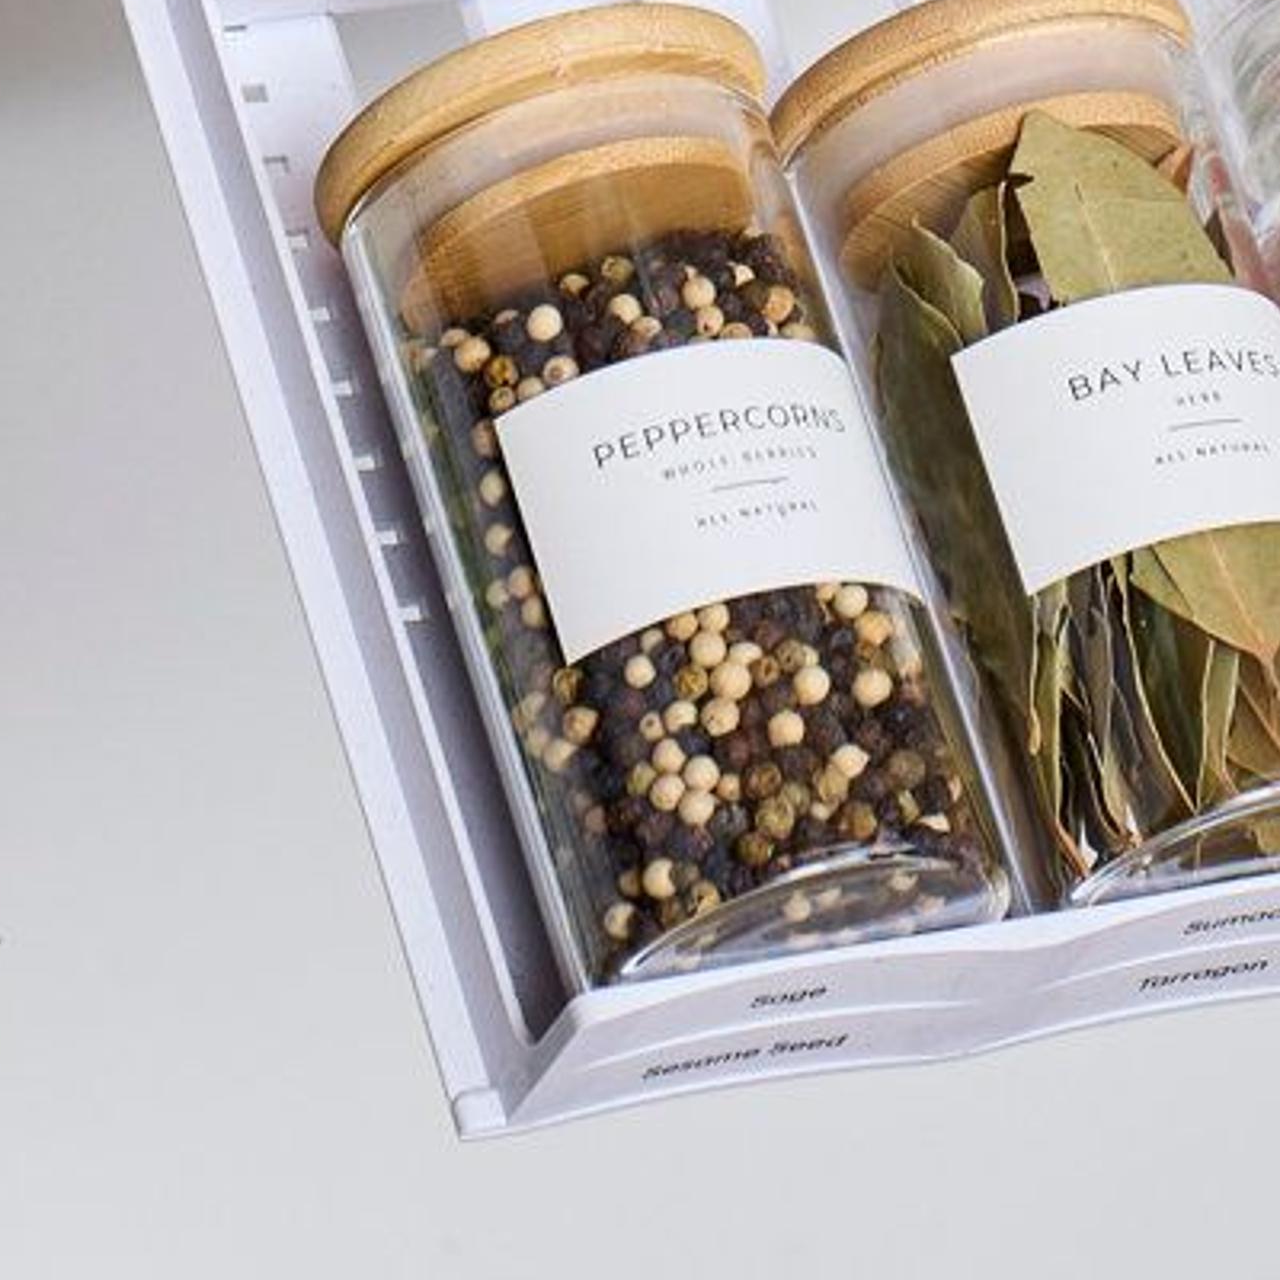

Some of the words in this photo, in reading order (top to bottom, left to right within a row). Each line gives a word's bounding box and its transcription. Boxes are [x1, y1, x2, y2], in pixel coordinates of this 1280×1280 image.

[1069, 359, 1143, 400] BAY
[1160, 350, 1280, 377] LEAVES
[593, 405, 846, 467] PEPPERCORNS
[750, 985, 829, 1009] Sage
[1139, 959, 1270, 992] Tarragon
[641, 1048, 762, 1081] Sesame
[768, 1033, 850, 1057] Seed
